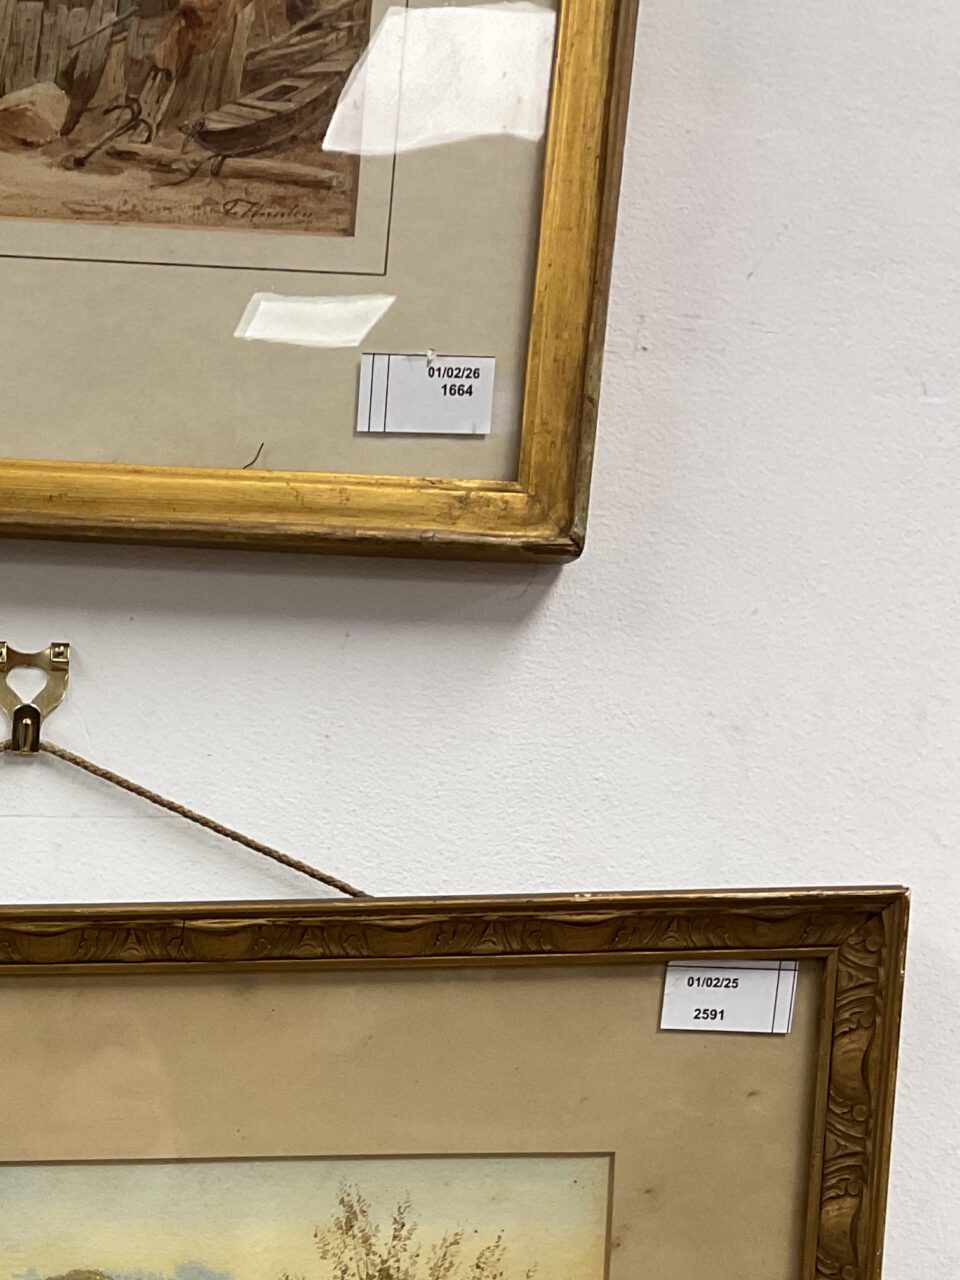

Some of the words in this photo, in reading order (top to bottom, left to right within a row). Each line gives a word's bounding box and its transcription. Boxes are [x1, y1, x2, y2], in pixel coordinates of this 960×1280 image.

[427, 366, 480, 379] 01/02/26
[441, 384, 473, 396] 1664
[687, 976, 739, 988] 01/02/25
[693, 1008, 725, 1020] 2591
